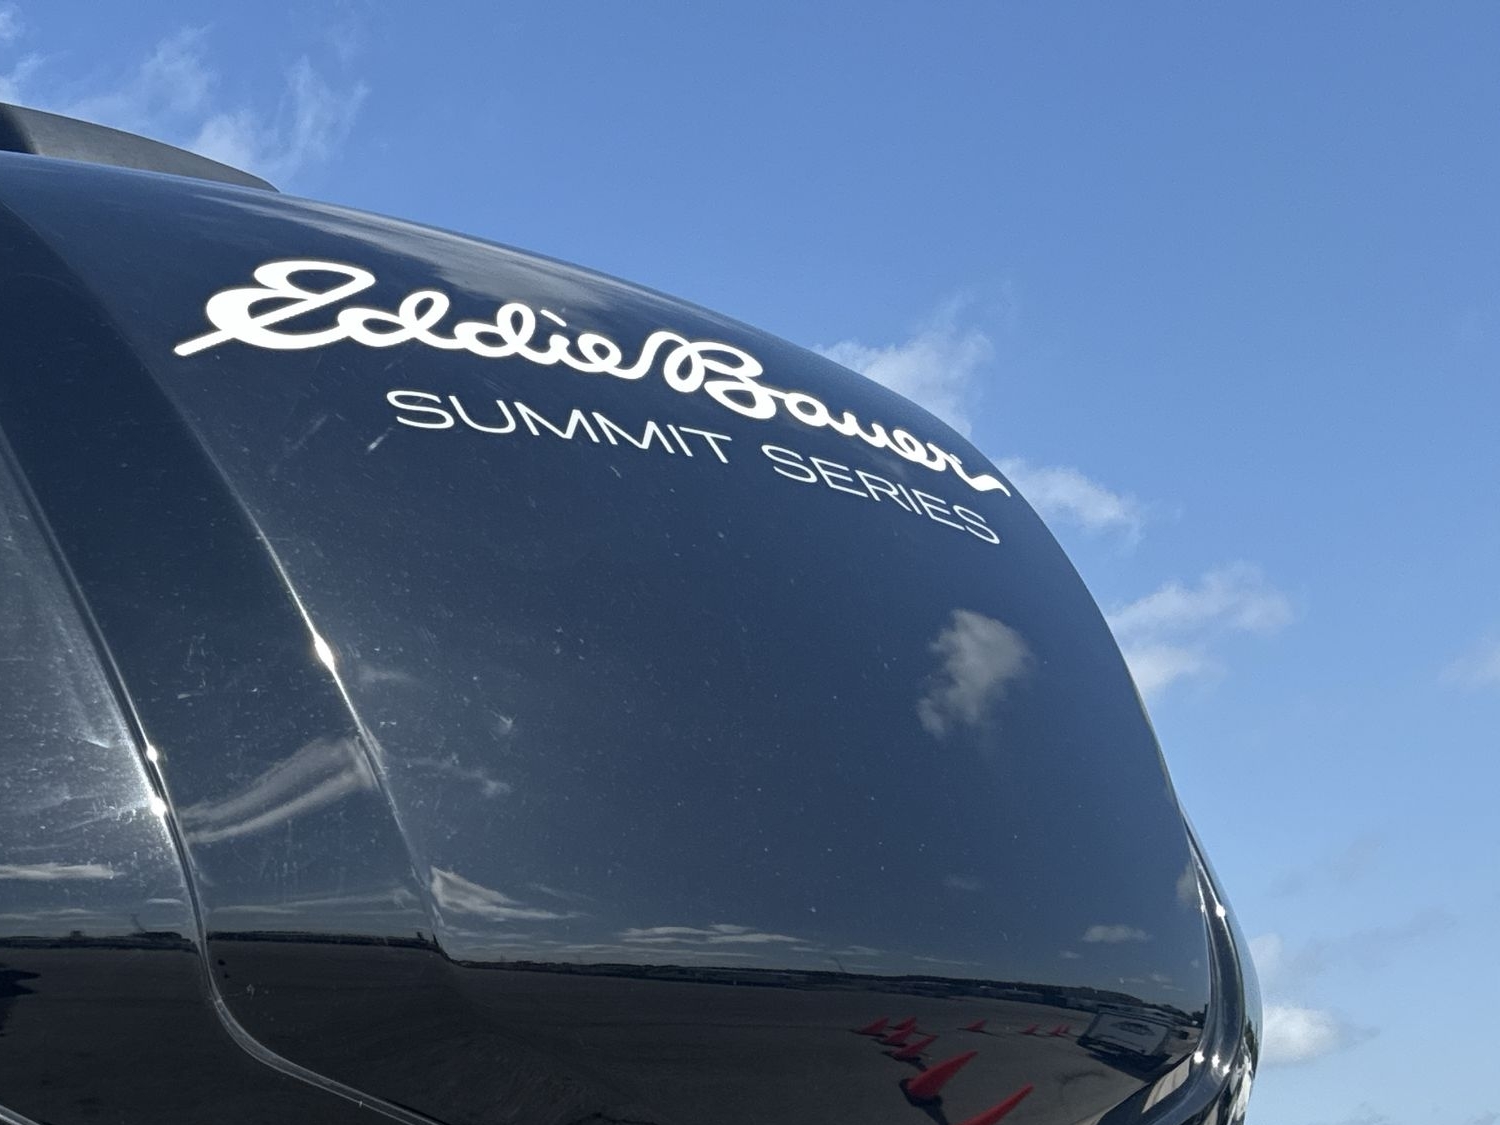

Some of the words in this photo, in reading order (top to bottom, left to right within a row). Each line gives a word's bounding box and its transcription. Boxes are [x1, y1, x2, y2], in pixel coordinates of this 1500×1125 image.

[173, 259, 632, 380] Eddie
[632, 329, 1013, 497] Bauer
[385, 390, 733, 465] SUMMIT
[761, 443, 1002, 546] SERIES
